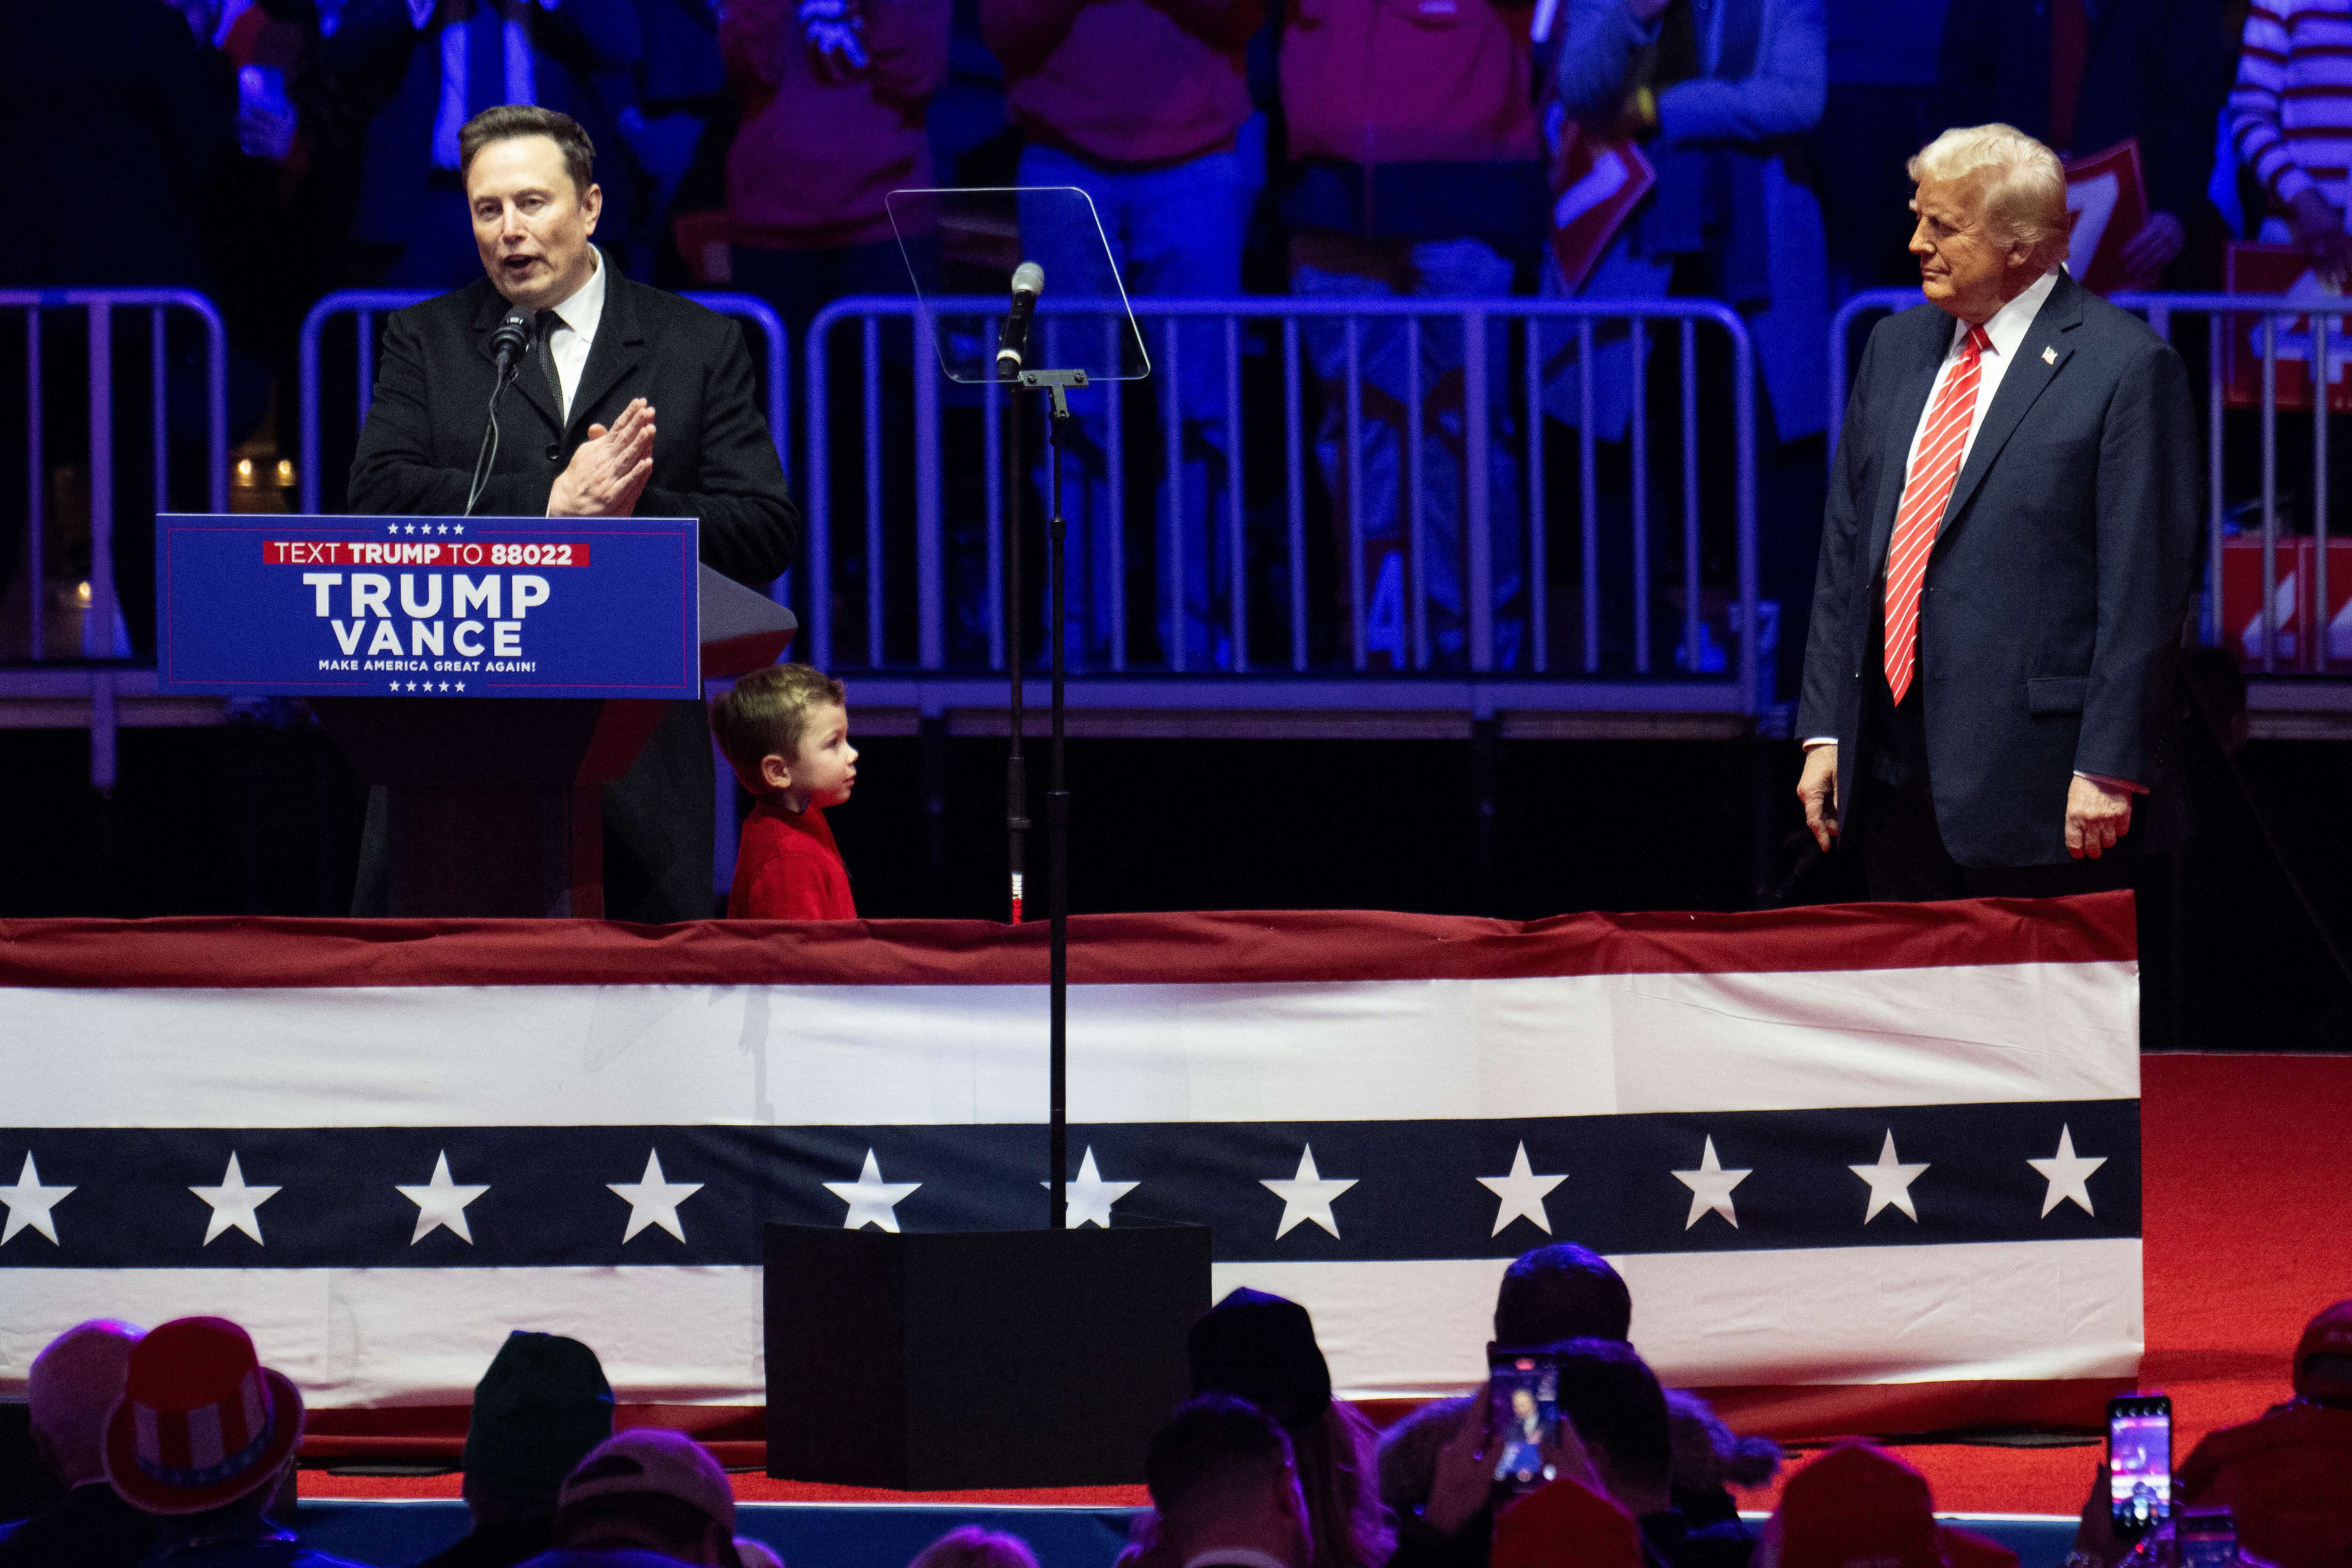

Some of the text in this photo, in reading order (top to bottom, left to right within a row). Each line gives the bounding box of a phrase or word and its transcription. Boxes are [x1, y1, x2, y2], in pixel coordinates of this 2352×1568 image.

[274, 542, 572, 565] TEXT TRUMP TO 88022
[302, 573, 550, 619] TRUMP
[331, 620, 522, 657] VANCE
[318, 660, 536, 672] MAKE AMERICA GREAT AGAIN!
